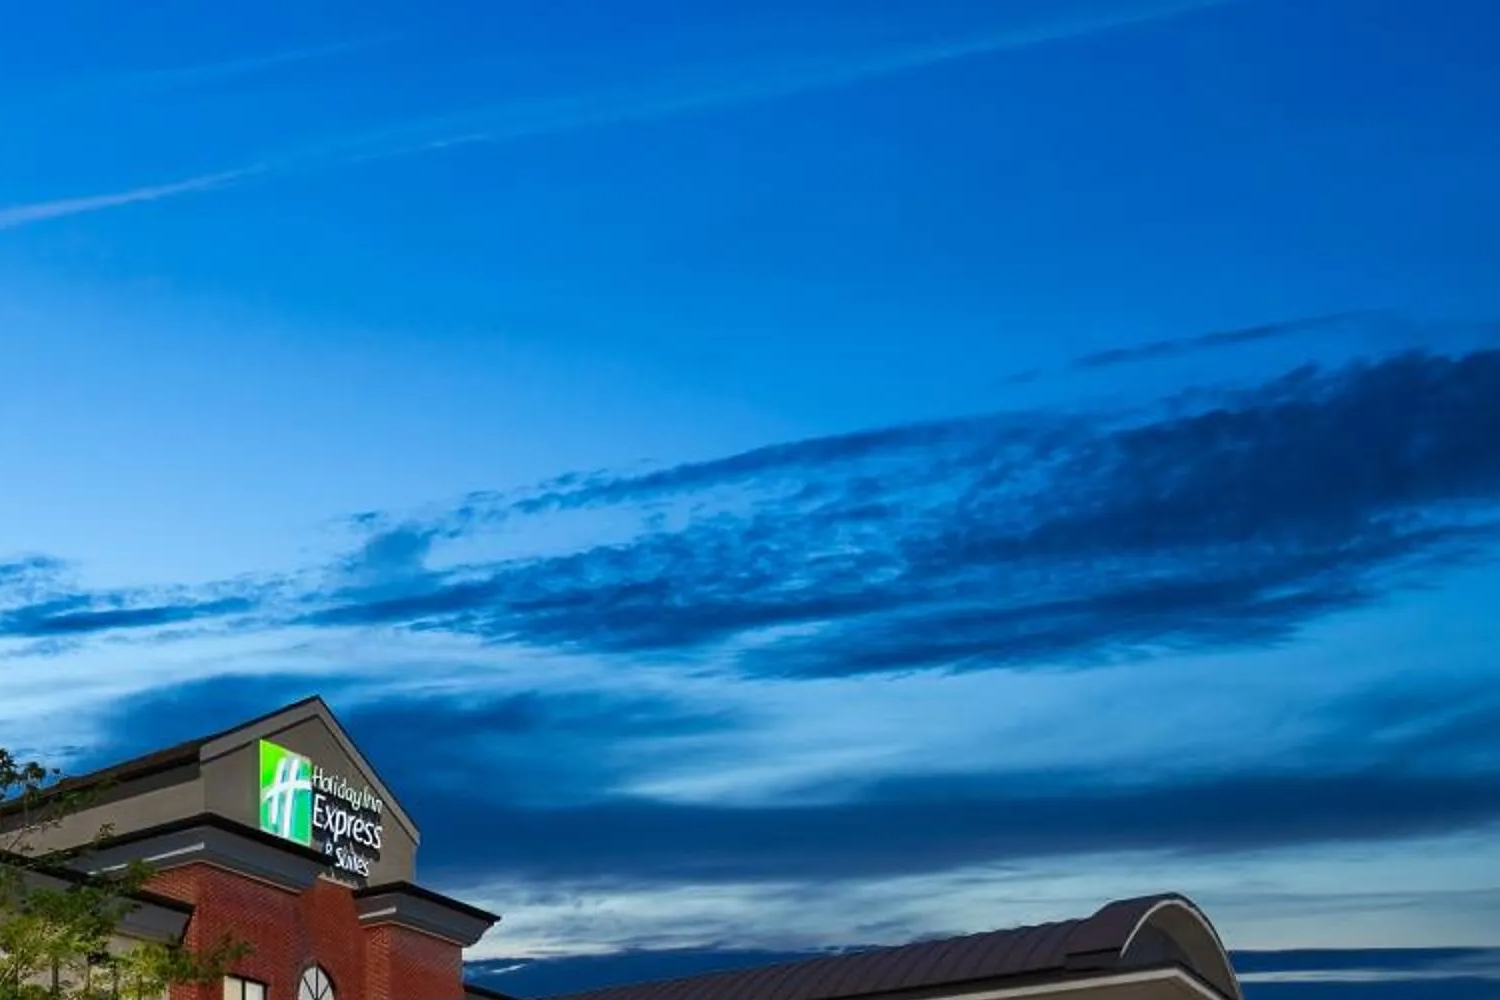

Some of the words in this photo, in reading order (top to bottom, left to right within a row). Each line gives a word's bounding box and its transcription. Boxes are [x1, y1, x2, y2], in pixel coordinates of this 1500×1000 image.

[312, 765, 361, 810] Holiday
[363, 785, 384, 814] Inn
[313, 794, 384, 849] Express
[335, 845, 370, 877] Suites
